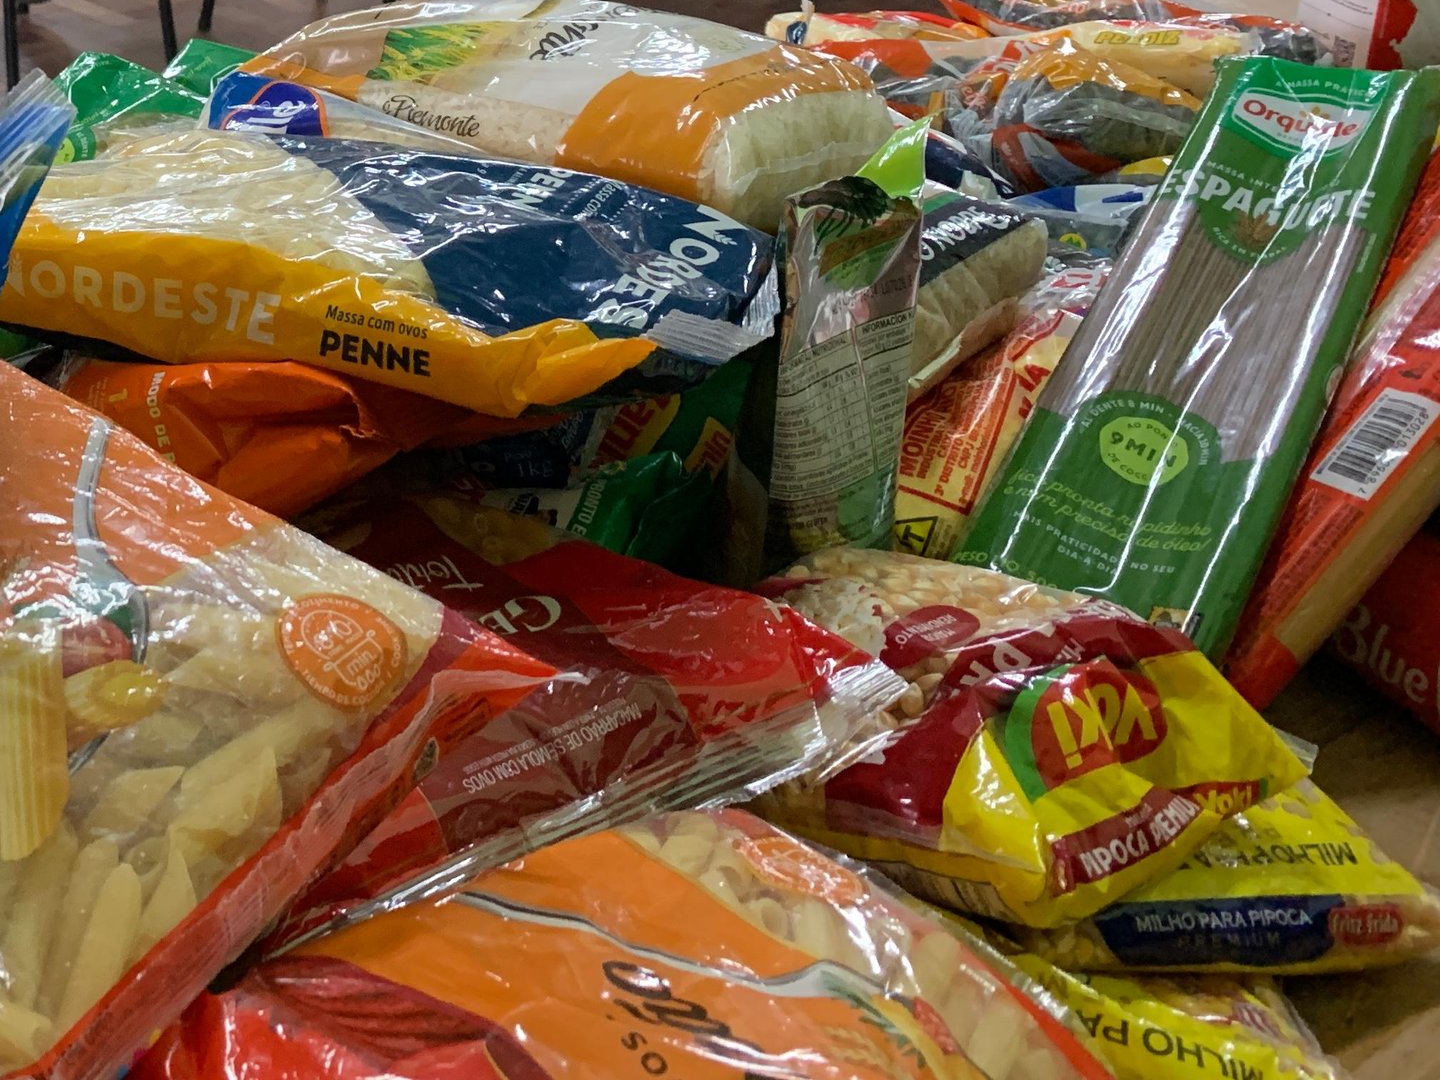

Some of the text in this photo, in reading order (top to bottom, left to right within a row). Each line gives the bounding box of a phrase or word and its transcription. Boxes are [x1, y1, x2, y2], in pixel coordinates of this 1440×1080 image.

[391, 94, 481, 138] Piemonte
[1160, 168, 1376, 232] ESPAGUETE
[600, 204, 750, 331] NORDES
[326, 305, 428, 341] Massa com ovos
[319, 328, 432, 378] PENNE
[147, 371, 166, 418] MODO
[1092, 399, 1124, 419] DENTE
[1140, 400, 1165, 413] MIN
[155, 424, 170, 447] DE
[1396, 408, 1433, 449] 013028
[939, 437, 965, 484] DISTRITO
[1044, 482, 1117, 519] pronta
[1056, 503, 1133, 543] preciso
[1135, 533, 1159, 550] de
[1162, 534, 1212, 553] óleo!
[1046, 523, 1121, 563] PRATICIDAD
[1130, 562, 1148, 572] NO
[1153, 563, 1175, 575] SEU
[564, 730, 585, 752] DE
[580, 701, 643, 743] MACARRÃO
[1046, 681, 1158, 770] Yoki
[491, 761, 522, 782] COM
[520, 738, 567, 771] SÊMOLA
[462, 770, 497, 795] OVOS
[1195, 784, 1254, 817] Yoki
[1271, 841, 1358, 867] MILHO
[1135, 908, 1314, 932] MILHO PARA PIPOCA
[1073, 1008, 1265, 1080] PA MILHO
